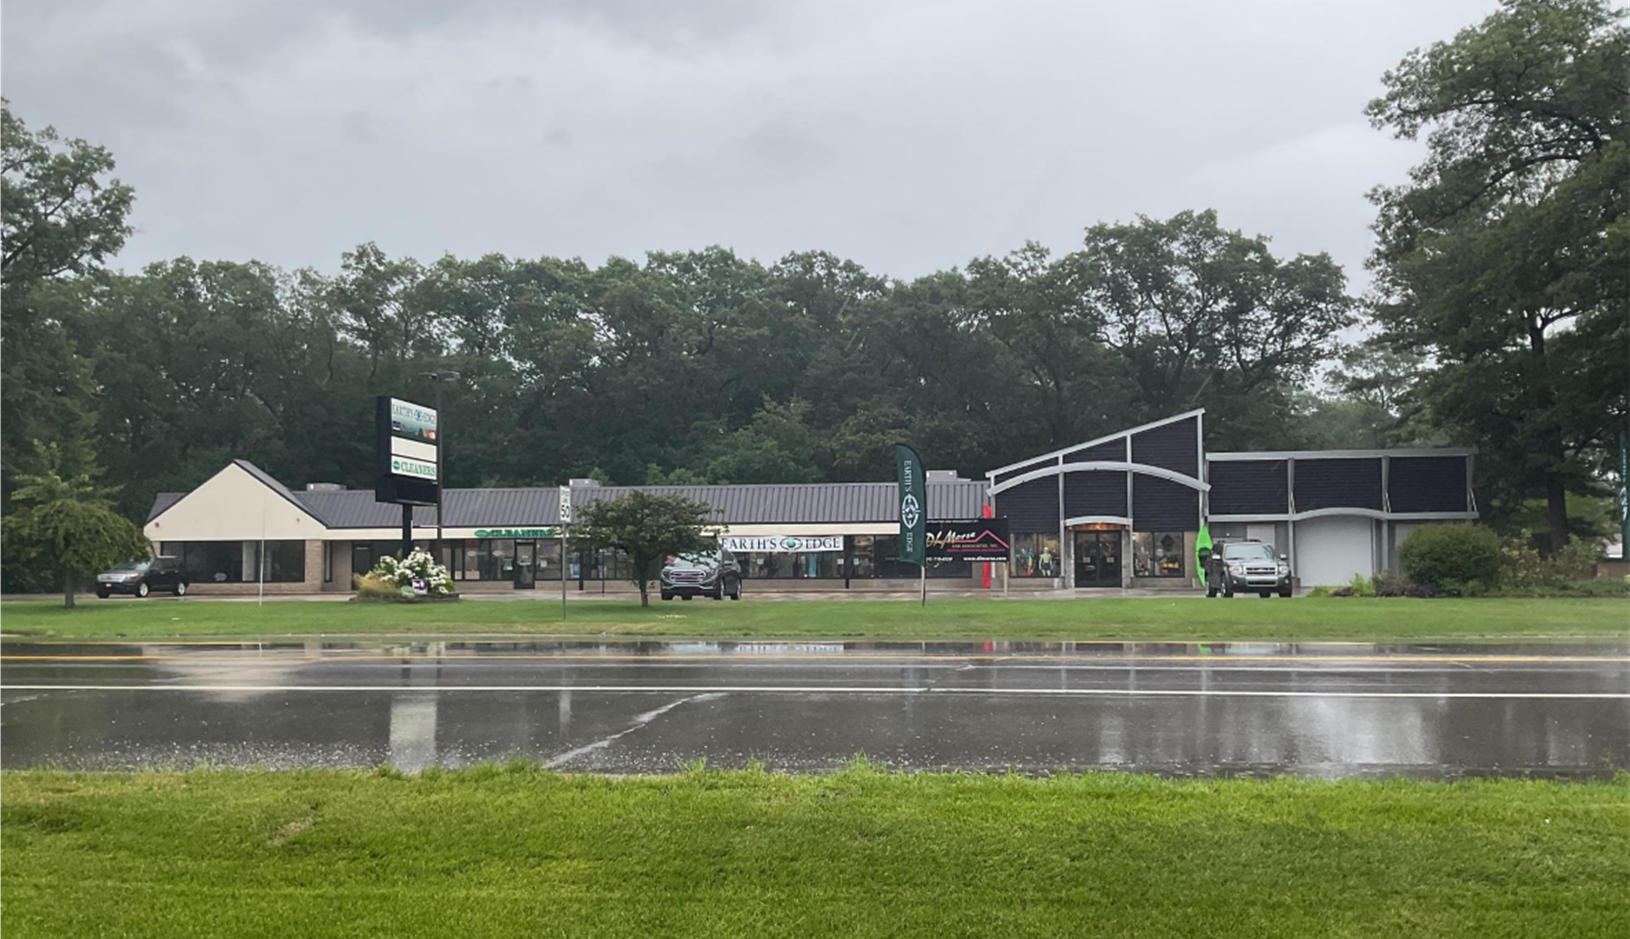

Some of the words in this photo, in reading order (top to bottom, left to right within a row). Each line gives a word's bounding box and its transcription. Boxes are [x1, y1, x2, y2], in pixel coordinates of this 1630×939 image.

[401, 461, 436, 477] CLEANERS
[561, 504, 570, 518] 50
[721, 537, 777, 551] EARTH'S
[805, 536, 841, 550] EDGE
[906, 532, 914, 553] EDGE
